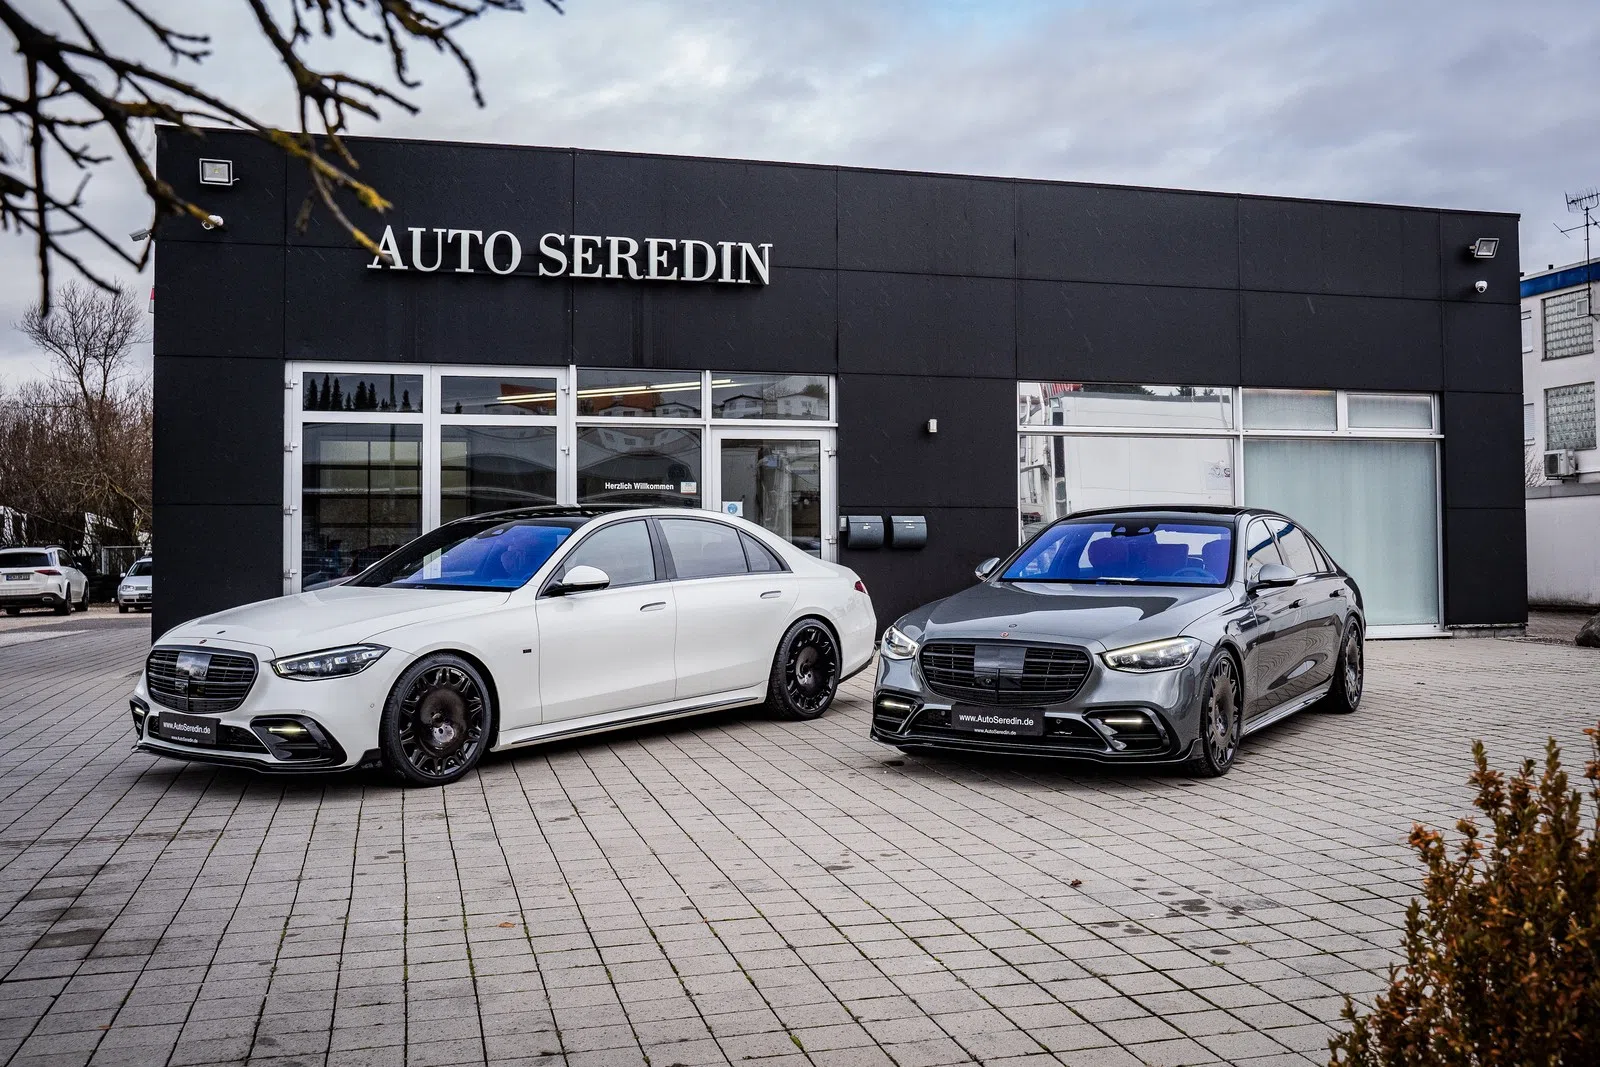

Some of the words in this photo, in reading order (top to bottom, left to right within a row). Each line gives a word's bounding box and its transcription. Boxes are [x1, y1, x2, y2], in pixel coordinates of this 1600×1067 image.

[367, 225, 522, 275] AUTO
[538, 233, 773, 285] SEREDIN
[604, 482, 632, 490] Herzlich
[633, 482, 674, 490] Willkommen
[959, 714, 1034, 726] www.AutoSeredin.de
[162, 721, 211, 734] www.AutoSeredin.de
